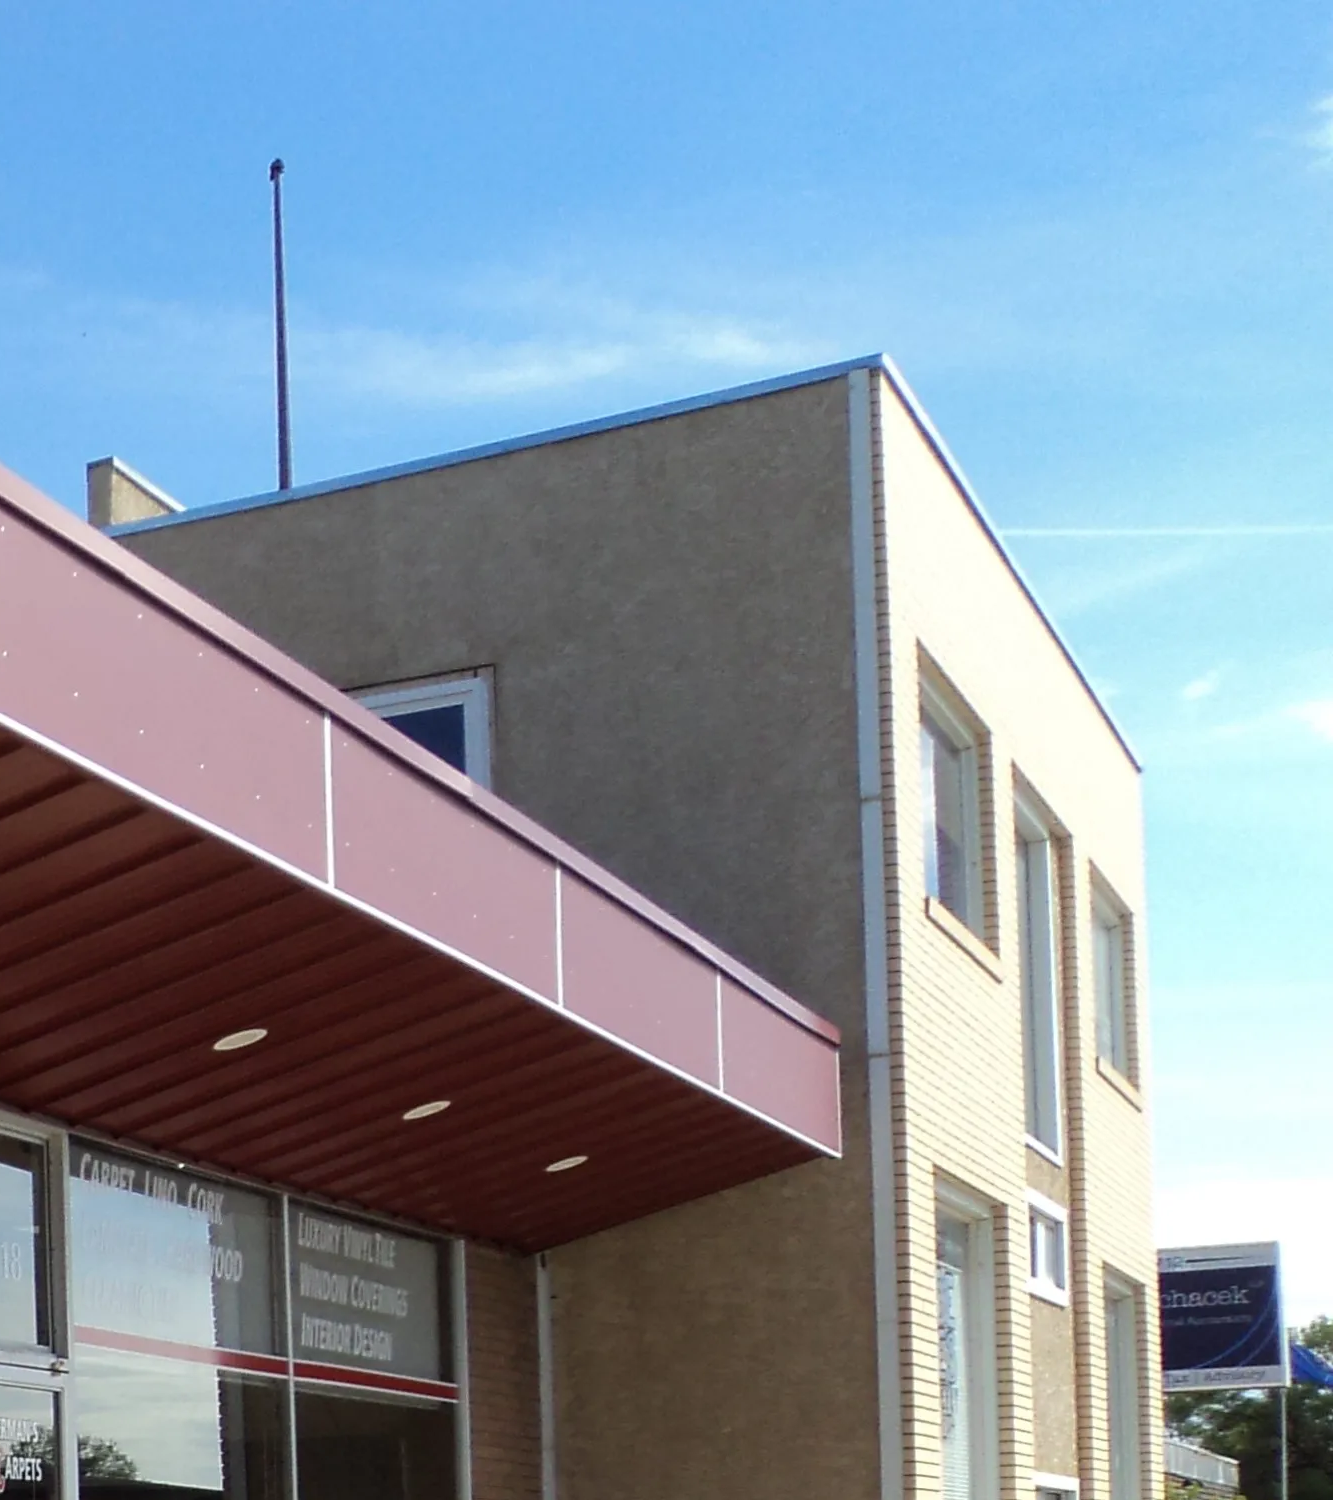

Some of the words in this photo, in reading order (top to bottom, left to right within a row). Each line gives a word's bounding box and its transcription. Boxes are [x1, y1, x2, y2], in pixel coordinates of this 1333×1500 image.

[79, 1153, 136, 1195] CARPET
[145, 1170, 178, 1207] LINO
[187, 1182, 225, 1225] CORK
[298, 1212, 341, 1255] LUXURY
[299, 1262, 349, 1306] WINDOW
[301, 1312, 352, 1354] INTERIOR
